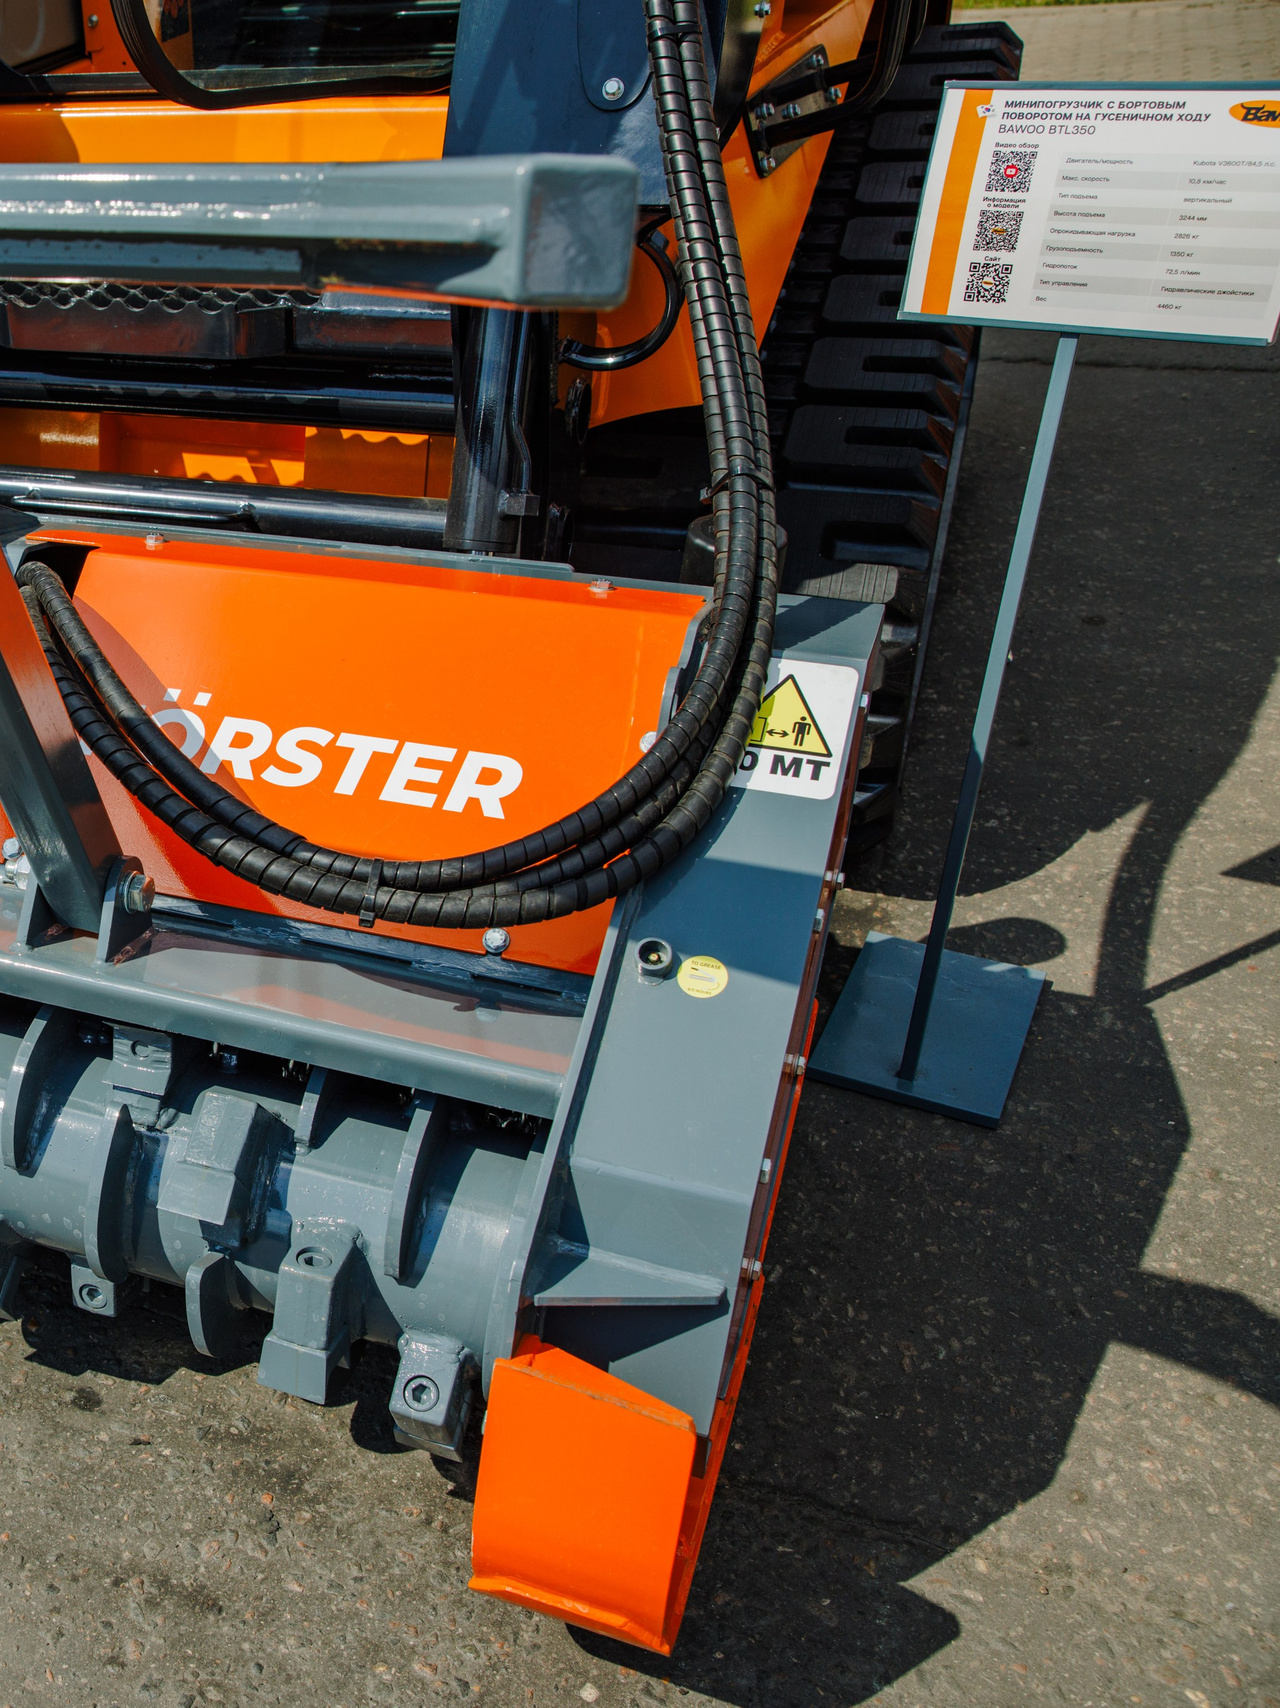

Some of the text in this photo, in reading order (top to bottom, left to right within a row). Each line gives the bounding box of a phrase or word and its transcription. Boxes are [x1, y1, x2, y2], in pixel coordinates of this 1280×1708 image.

[1004, 100, 1186, 110] МИНИПОГРУЗЧИК С БОРТОВЫМ
[1001, 112, 1212, 123] ПОВОРОТОМ НА ГУСЕНИЧНОМ ХОДУ
[998, 124, 1096, 135] BAWOO BTL350
[1018, 142, 1040, 150] обзор
[982, 196, 1026, 204] Информация
[1183, 196, 1233, 204] вертикальный
[1050, 228, 1106, 237] Опрокидывающая
[1046, 245, 1104, 254] Грузоподъемность
[1042, 262, 1078, 270] Гидропоток
[1161, 286, 1255, 297] Гидравлические джойстики
[82, 688, 523, 820] ÖRSTER
[769, 754, 831, 781] MT
[700, 962, 721, 970] GREASE
